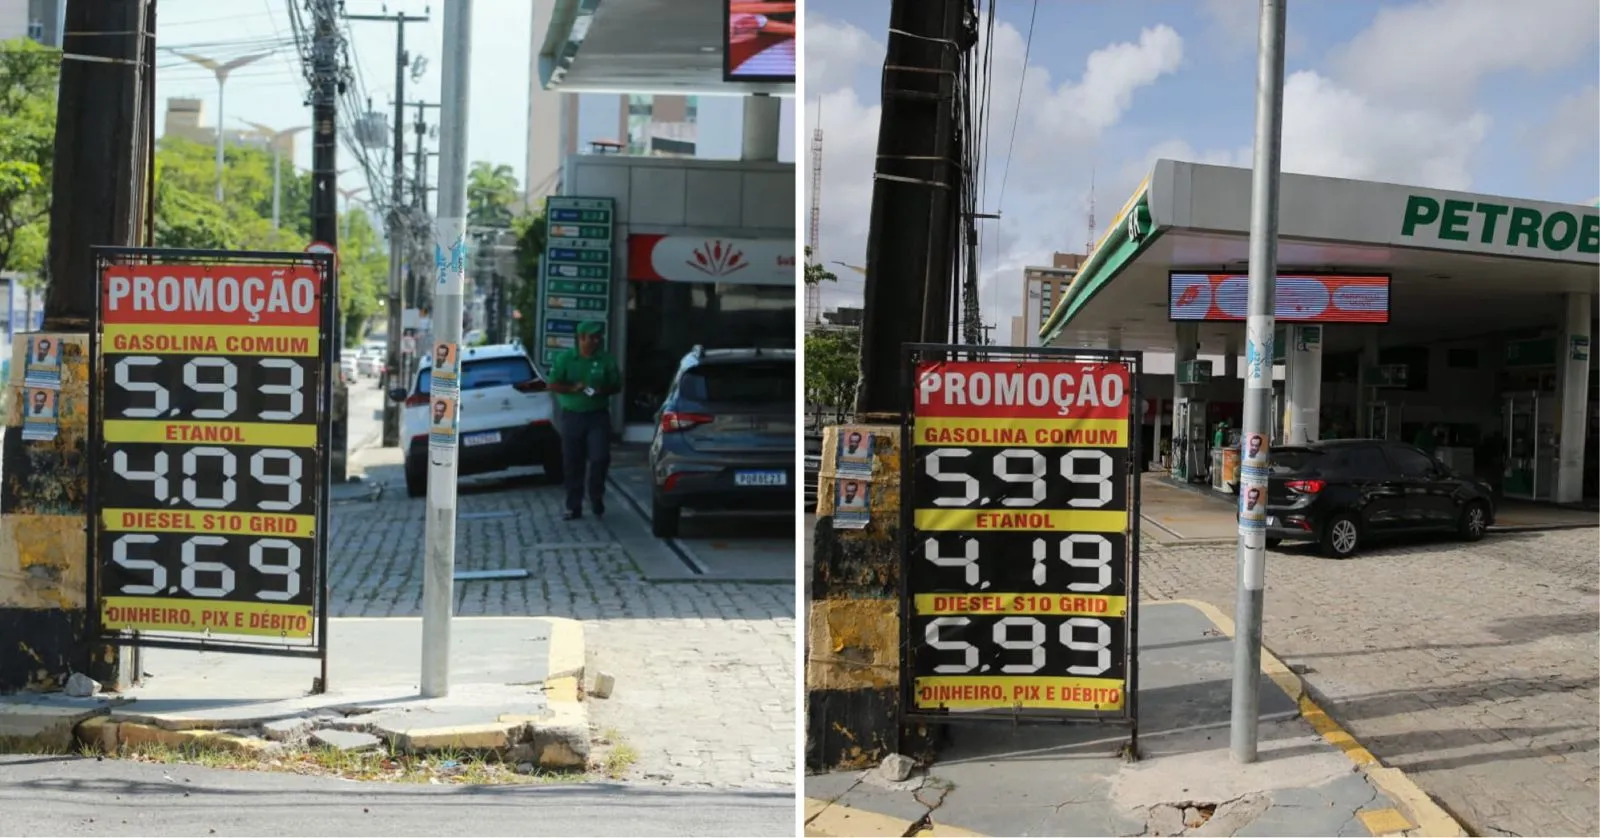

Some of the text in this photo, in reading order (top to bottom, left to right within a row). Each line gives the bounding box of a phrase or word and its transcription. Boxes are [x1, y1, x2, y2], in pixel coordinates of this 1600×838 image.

[107, 269, 315, 323] PROMOÇÃO
[114, 335, 309, 353] GASOLINA COMUM
[114, 355, 304, 421] 5.93
[919, 366, 1124, 416] PROMOÇÃO
[165, 425, 246, 442] ETANOL
[924, 427, 1118, 445] GASOLINA COMUM
[112, 446, 303, 511] 4.09
[925, 447, 1114, 507] 5.99
[122, 512, 298, 533] DIESEL S10 GRID
[975, 512, 1055, 529] ETANOL
[112, 533, 302, 601] 5.69
[933, 596, 1108, 613] DIESEL S10 GRID
[108, 606, 307, 632] DINHEIRO, PIX E DÉBITO
[925, 615, 1113, 675] 5.99
[921, 684, 1120, 704] DINHEIRO, PIX E DÉBITO
